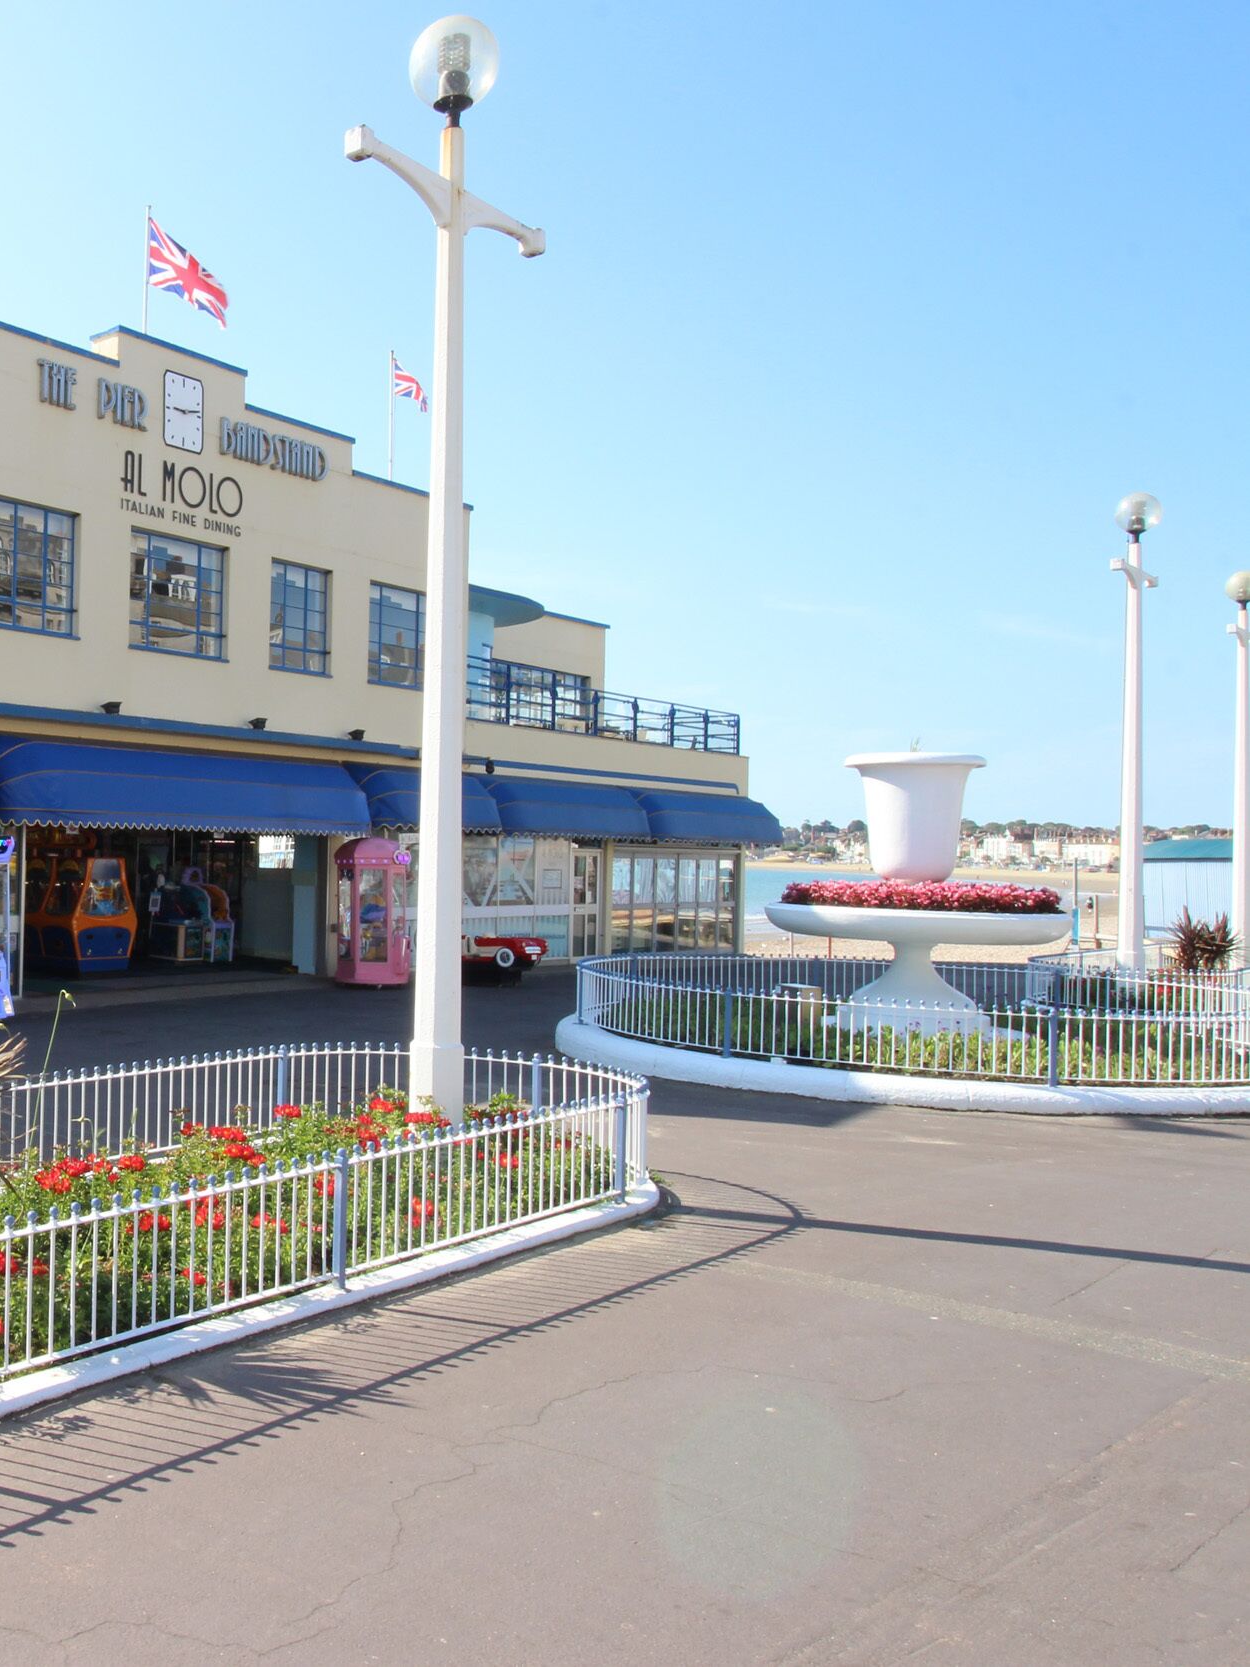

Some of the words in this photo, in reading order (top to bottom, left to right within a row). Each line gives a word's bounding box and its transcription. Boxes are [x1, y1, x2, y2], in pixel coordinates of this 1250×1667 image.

[37, 358, 77, 411] THE
[97, 377, 148, 432] PIER
[219, 416, 330, 482] BANDSTAND
[120, 450, 147, 497] AL
[162, 460, 243, 517] MOLO
[120, 498, 165, 519] ITALIAN
[172, 510, 197, 527] FINE
[204, 518, 242, 537] DINING
